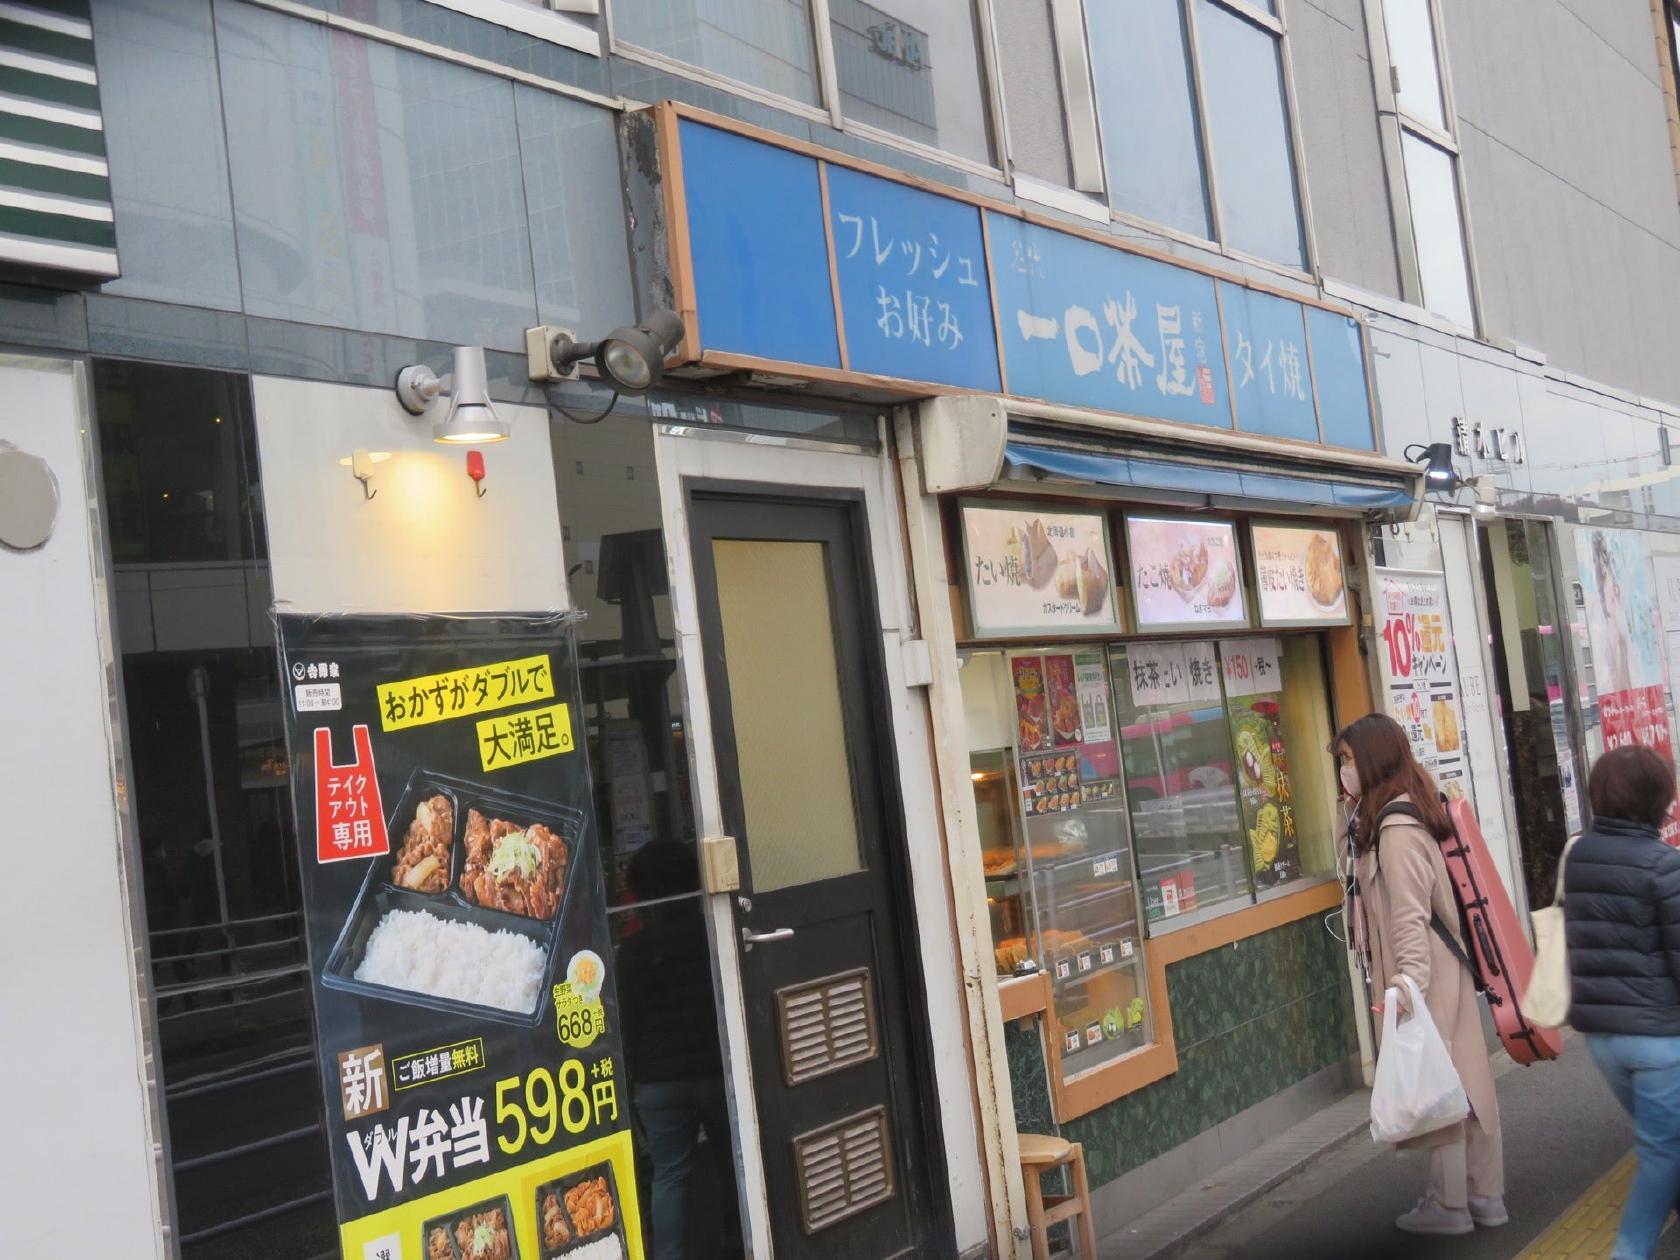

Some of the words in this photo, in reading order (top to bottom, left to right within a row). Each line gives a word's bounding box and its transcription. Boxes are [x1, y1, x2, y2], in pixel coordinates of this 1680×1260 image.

[838, 211, 979, 287] フレッシュ
[876, 284, 964, 350] お好み
[1016, 289, 1196, 397] 一口茶屋
[1234, 329, 1306, 401] タイ焼
[975, 555, 1021, 587] たい焼
[1137, 562, 1172, 591] たこ焼
[1384, 613, 1421, 677] 10%
[1418, 614, 1446, 653] 還元
[384, 662, 548, 722] おかずがダブルで
[484, 712, 570, 766] 大満足。
[328, 774, 368, 797] テイク
[328, 797, 369, 818] アウト
[331, 819, 373, 850] 専用
[558, 1008, 604, 1041] 668円
[342, 1049, 382, 1115] 新
[399, 1043, 480, 1082] ご飯増量無料
[591, 1056, 614, 1080] +税
[495, 1058, 619, 1155] 598円
[346, 1096, 491, 1202] W弁当
